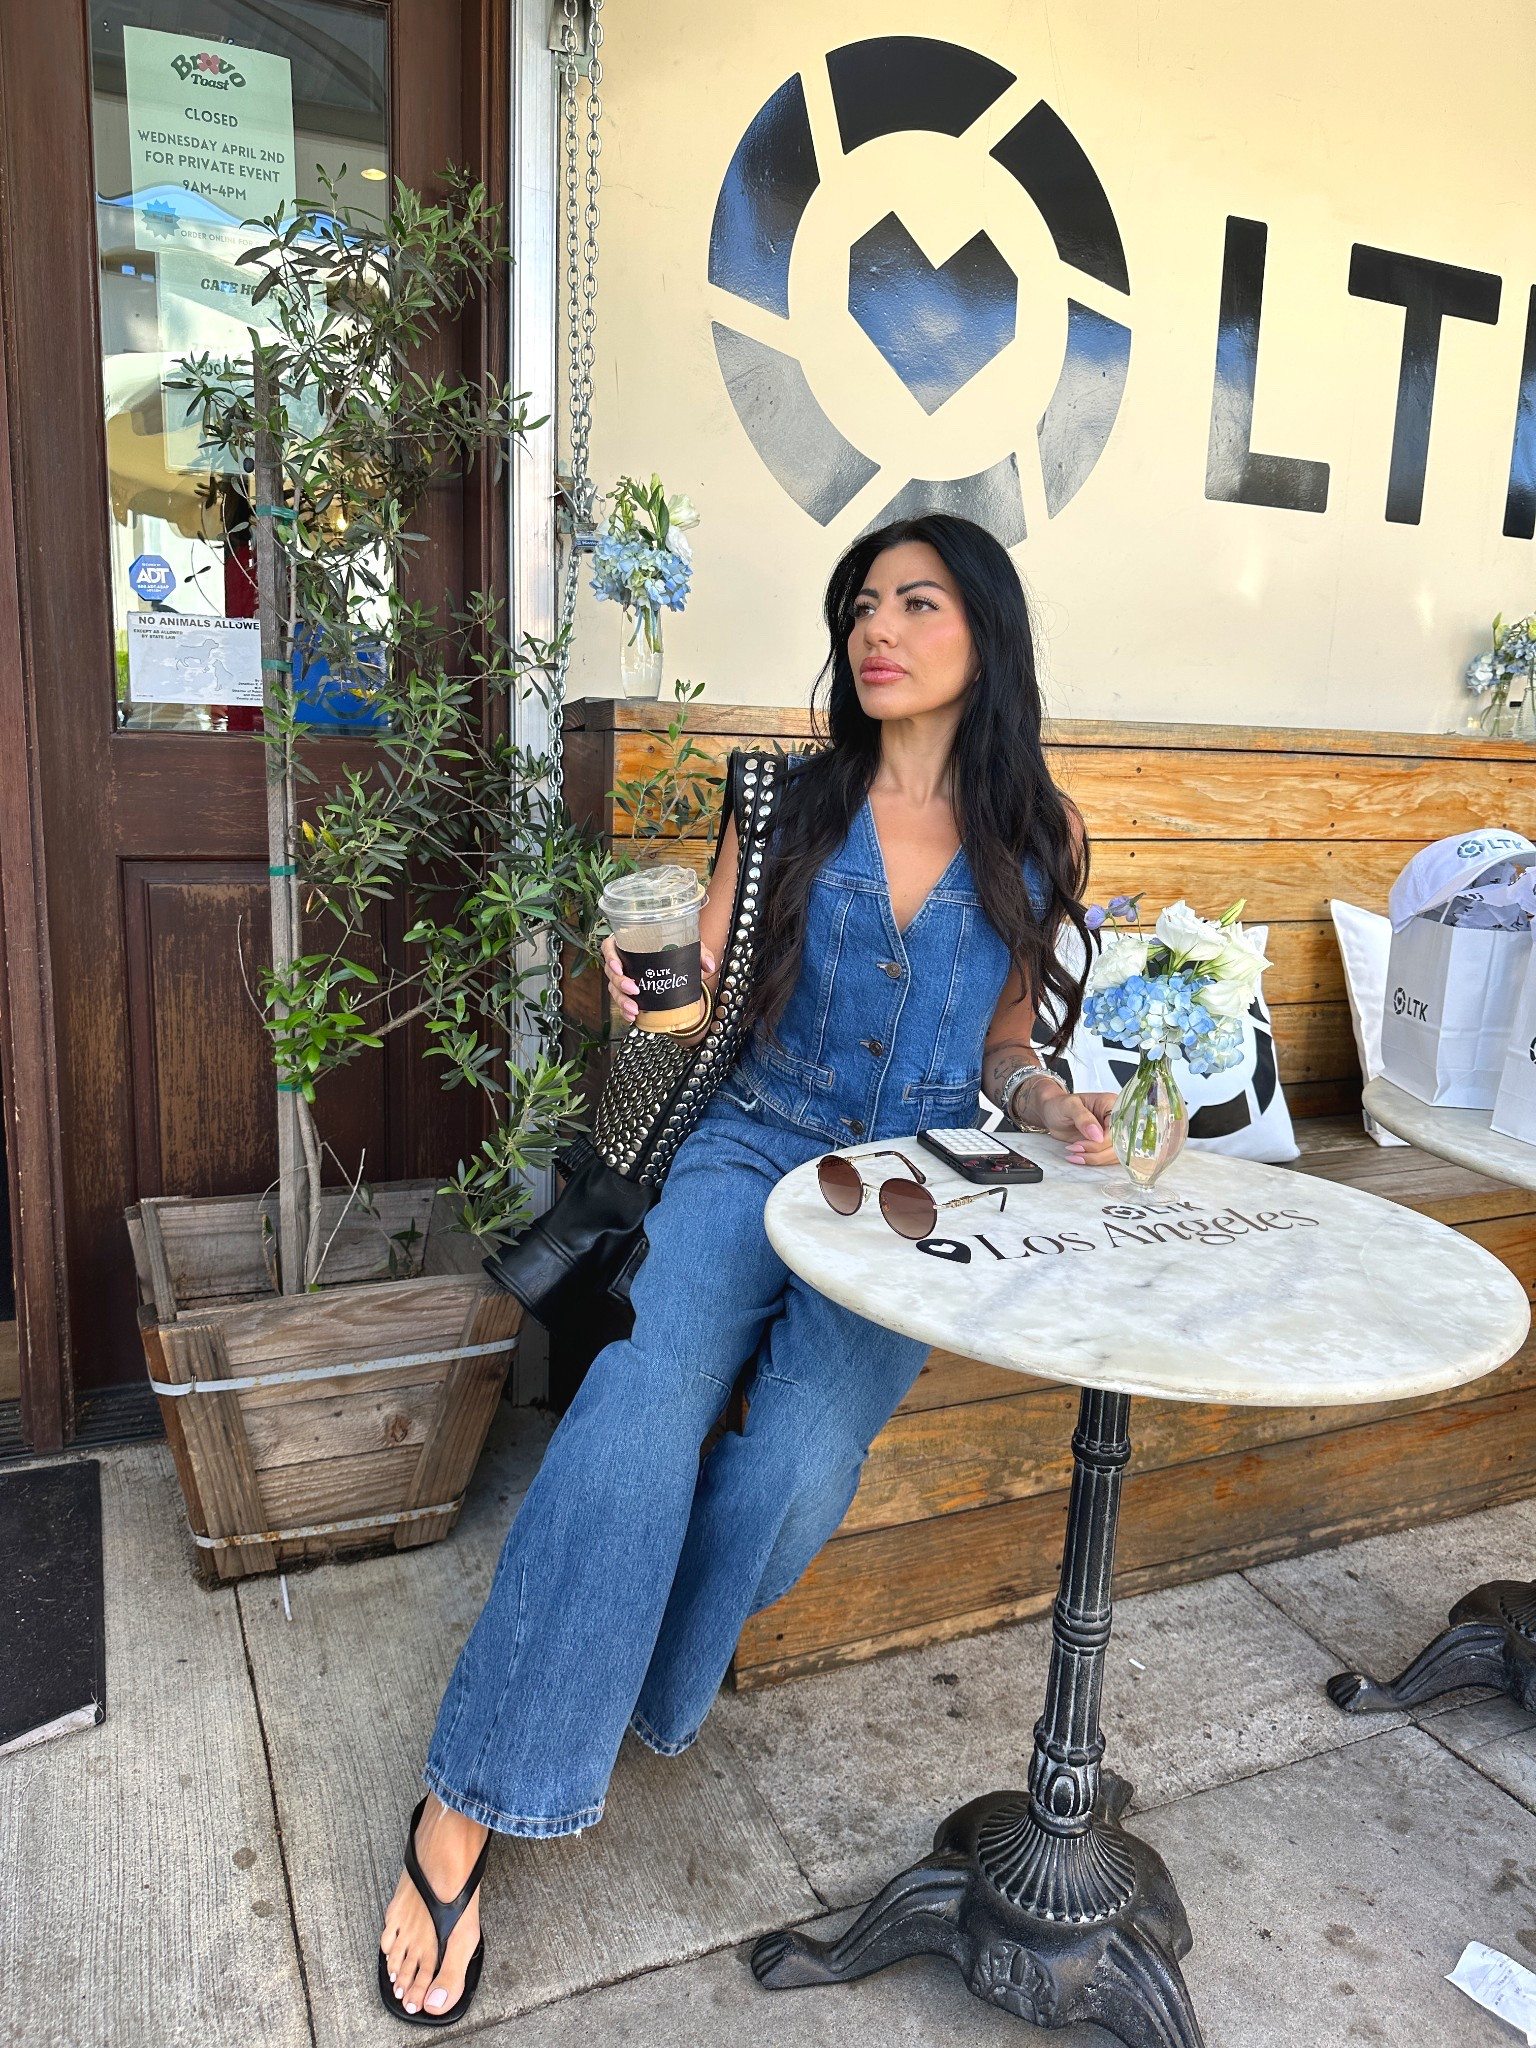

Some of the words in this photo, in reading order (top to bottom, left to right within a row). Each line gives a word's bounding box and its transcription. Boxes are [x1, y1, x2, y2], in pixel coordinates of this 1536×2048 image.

[191, 74, 229, 90] Toast
[184, 107, 238, 127] CLOSED
[137, 129, 217, 151] WEDNESDAY
[221, 143, 257, 160] APRIL
[260, 149, 285, 164] 2ND
[145, 150, 174, 165] FOR
[178, 154, 235, 175] PRIVATE
[239, 165, 280, 183] EVENT
[182, 179, 247, 200] 9AM-4PM
[180, 230, 207, 240] ORDER
[208, 234, 237, 245] ONLINE
[238, 238, 253, 246] FOR
[200, 278, 238, 294] CAFE
[1205, 214, 1536, 540] LT
[136, 567, 170, 583] ADT
[138, 616, 156, 625] NO
[159, 617, 211, 628] ANIMALS
[214, 620, 260, 630] ALLOWE
[656, 968, 671, 977] LTK
[638, 973, 689, 995] Angeles
[1407, 996, 1429, 1022] LTK
[971, 1232, 1096, 1261] Los
[1103, 1207, 1320, 1249] Angeles
